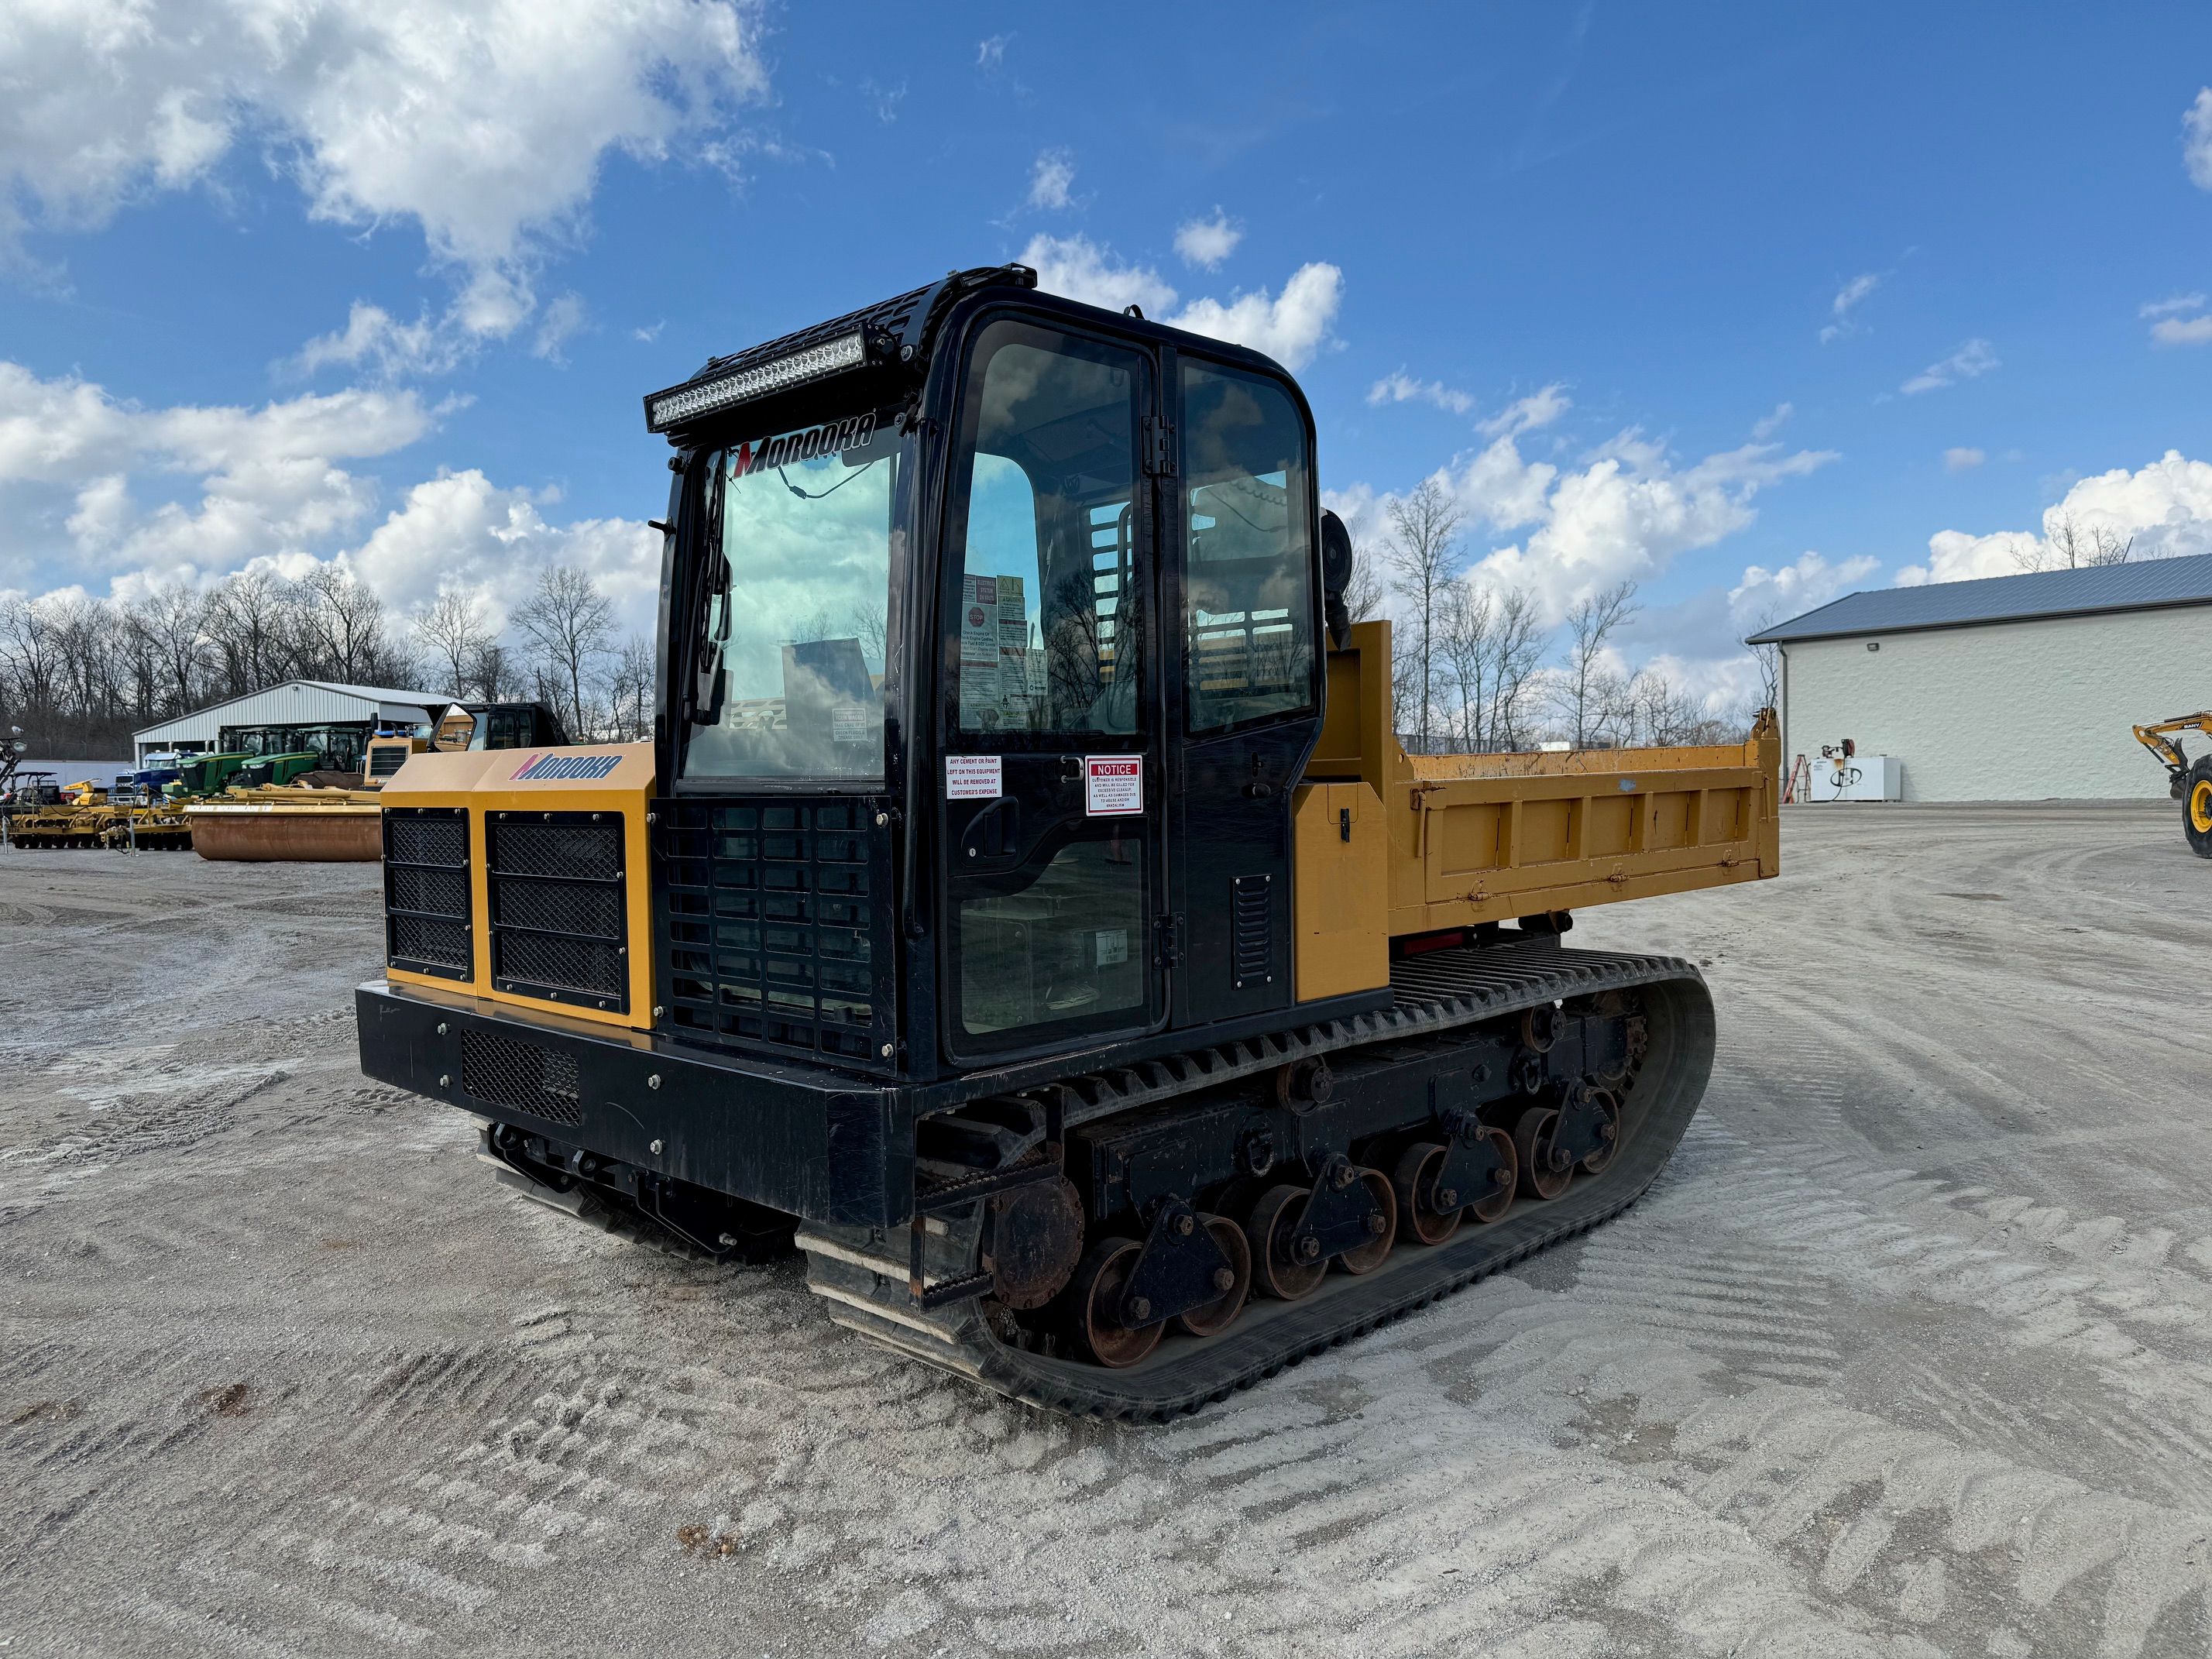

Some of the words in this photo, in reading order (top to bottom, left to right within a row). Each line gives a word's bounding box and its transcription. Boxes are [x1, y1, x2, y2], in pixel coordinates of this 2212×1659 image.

[733, 412, 876, 479] MOROOKA
[508, 753, 623, 781] MOROOKA
[1097, 764, 1132, 775] NOTICE
